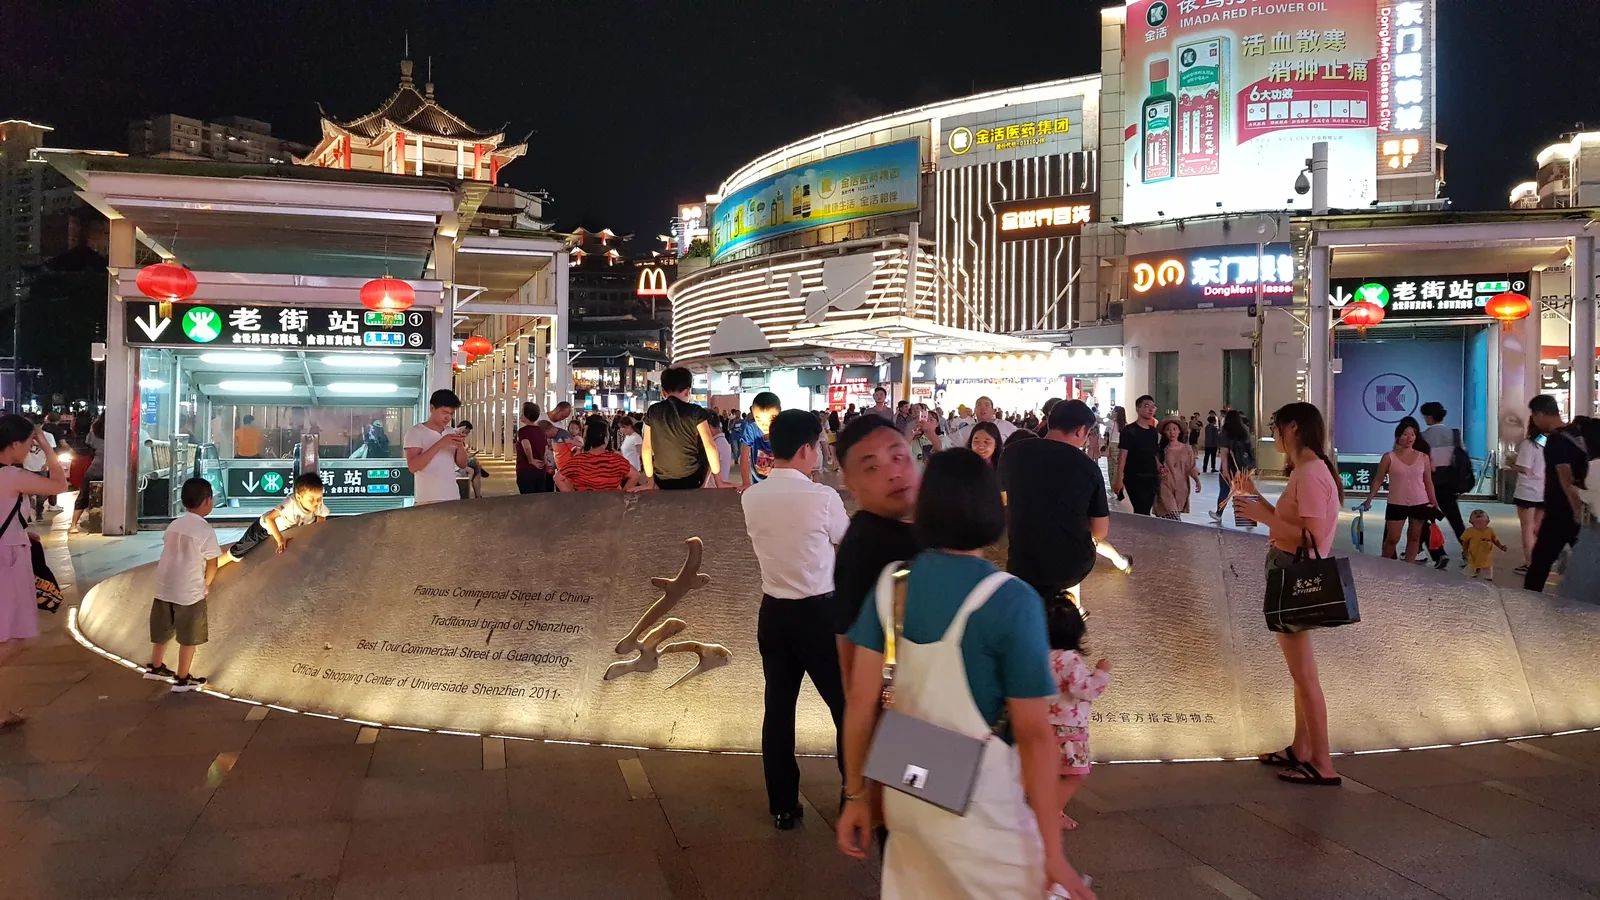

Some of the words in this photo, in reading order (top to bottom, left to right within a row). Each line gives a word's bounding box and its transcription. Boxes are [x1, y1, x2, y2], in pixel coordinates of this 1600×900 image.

[1180, 12, 1220, 28] IMADA
[1223, 8, 1248, 20] RED
[1251, 3, 1304, 16] FLOWER
[1307, 2, 1328, 11] OIL
[1145, 27, 1167, 43] 金活
[1241, 29, 1347, 56] 活血散寒
[1268, 59, 1369, 82] 消肿止痛
[1249, 86, 1294, 102] 6大功效
[976, 117, 1069, 145] 金活医药集团
[1204, 285, 1253, 297] DongMen
[1392, 279, 1474, 300] 老街站
[229, 307, 360, 333] 老街站
[413, 585, 450, 597] Famous
[452, 586, 509, 600] Commercial
[510, 589, 540, 601] Street
[544, 591, 557, 601] of
[430, 614, 479, 628] Traditional
[481, 618, 510, 630] brand
[512, 619, 526, 631] of
[356, 639, 378, 650] Best
[381, 640, 401, 652] Tour
[401, 642, 458, 657] Commercial
[459, 646, 490, 660] Street
[492, 649, 503, 660] of
[292, 662, 321, 677] Official
[322, 668, 364, 685] Shopping
[365, 672, 396, 686] Center
[397, 676, 410, 687] of
[410, 676, 469, 693] Universiade
[472, 682, 525, 697] Shenzhen
[1091, 711, 1216, 723] 动会官方指定购物点
